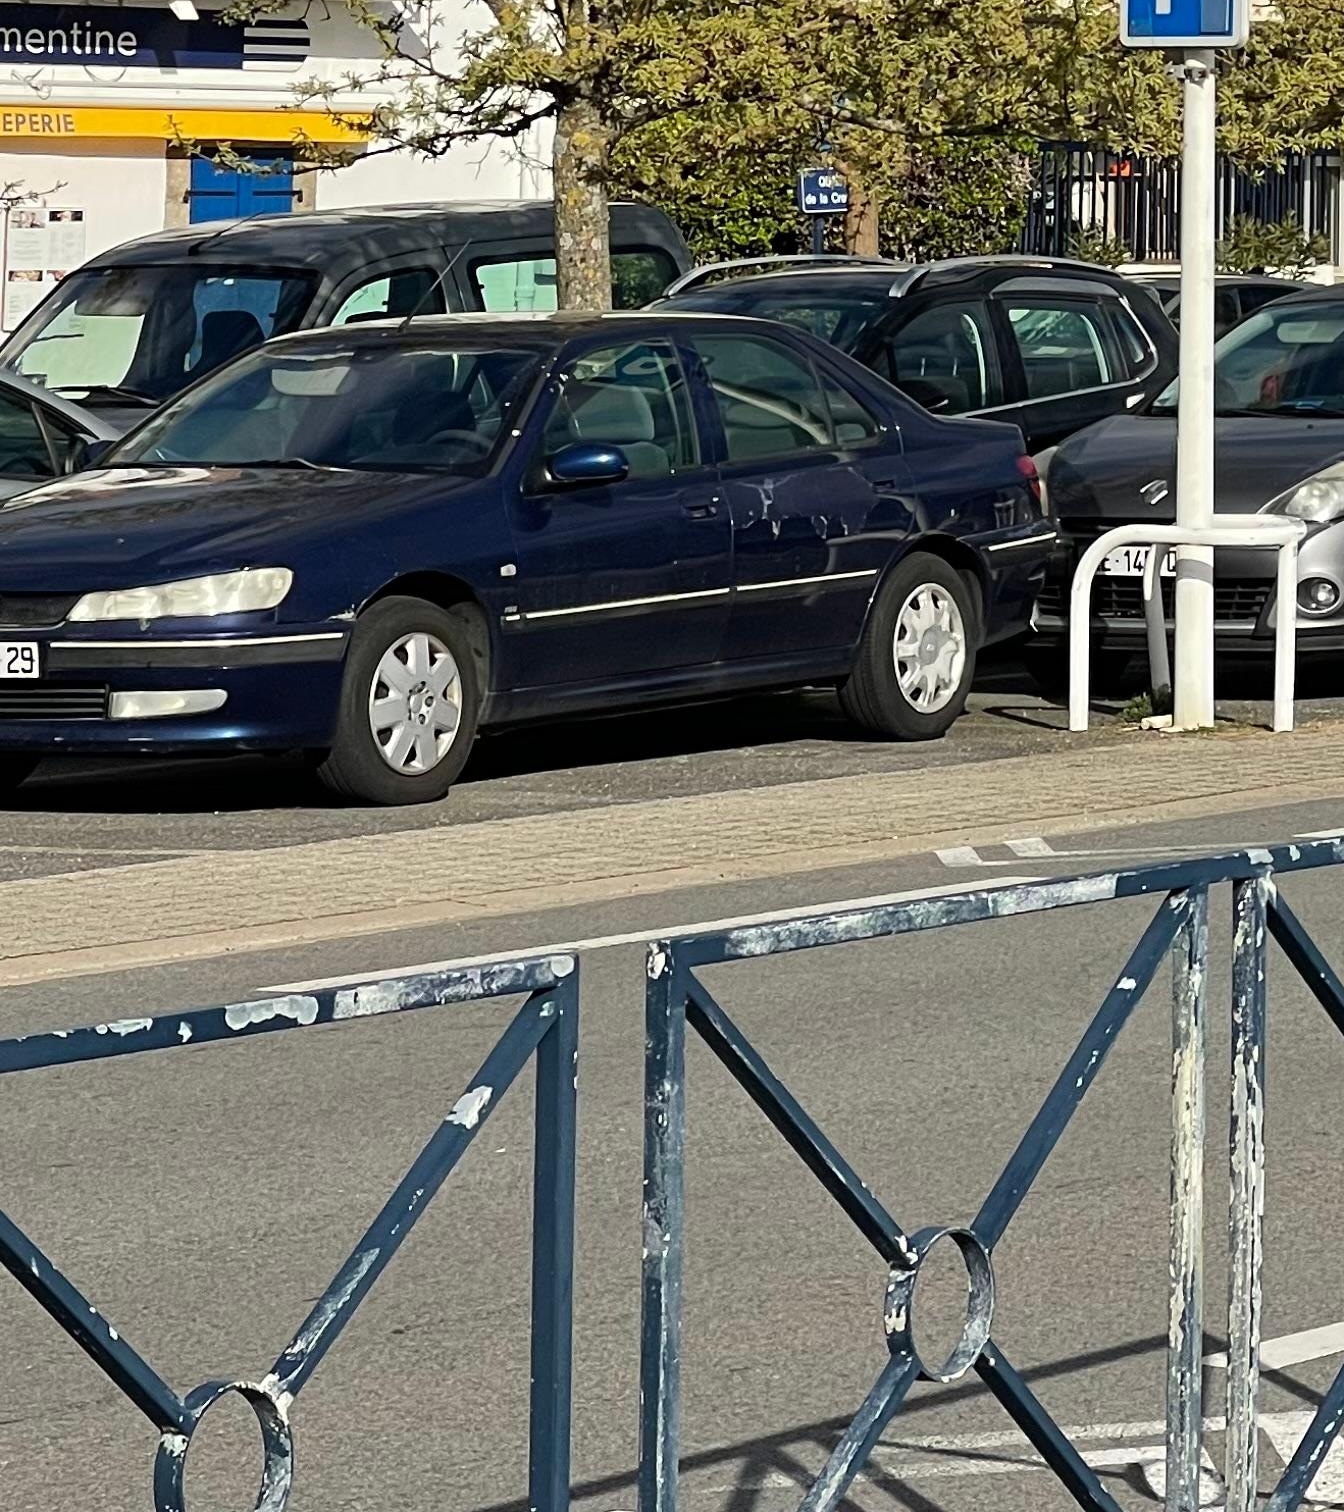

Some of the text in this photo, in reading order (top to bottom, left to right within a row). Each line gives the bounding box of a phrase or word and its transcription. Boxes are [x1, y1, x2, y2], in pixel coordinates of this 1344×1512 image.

[0, 21, 137, 56] mentine
[2, 112, 75, 134] EPERIE
[7, 647, 34, 674] 29
